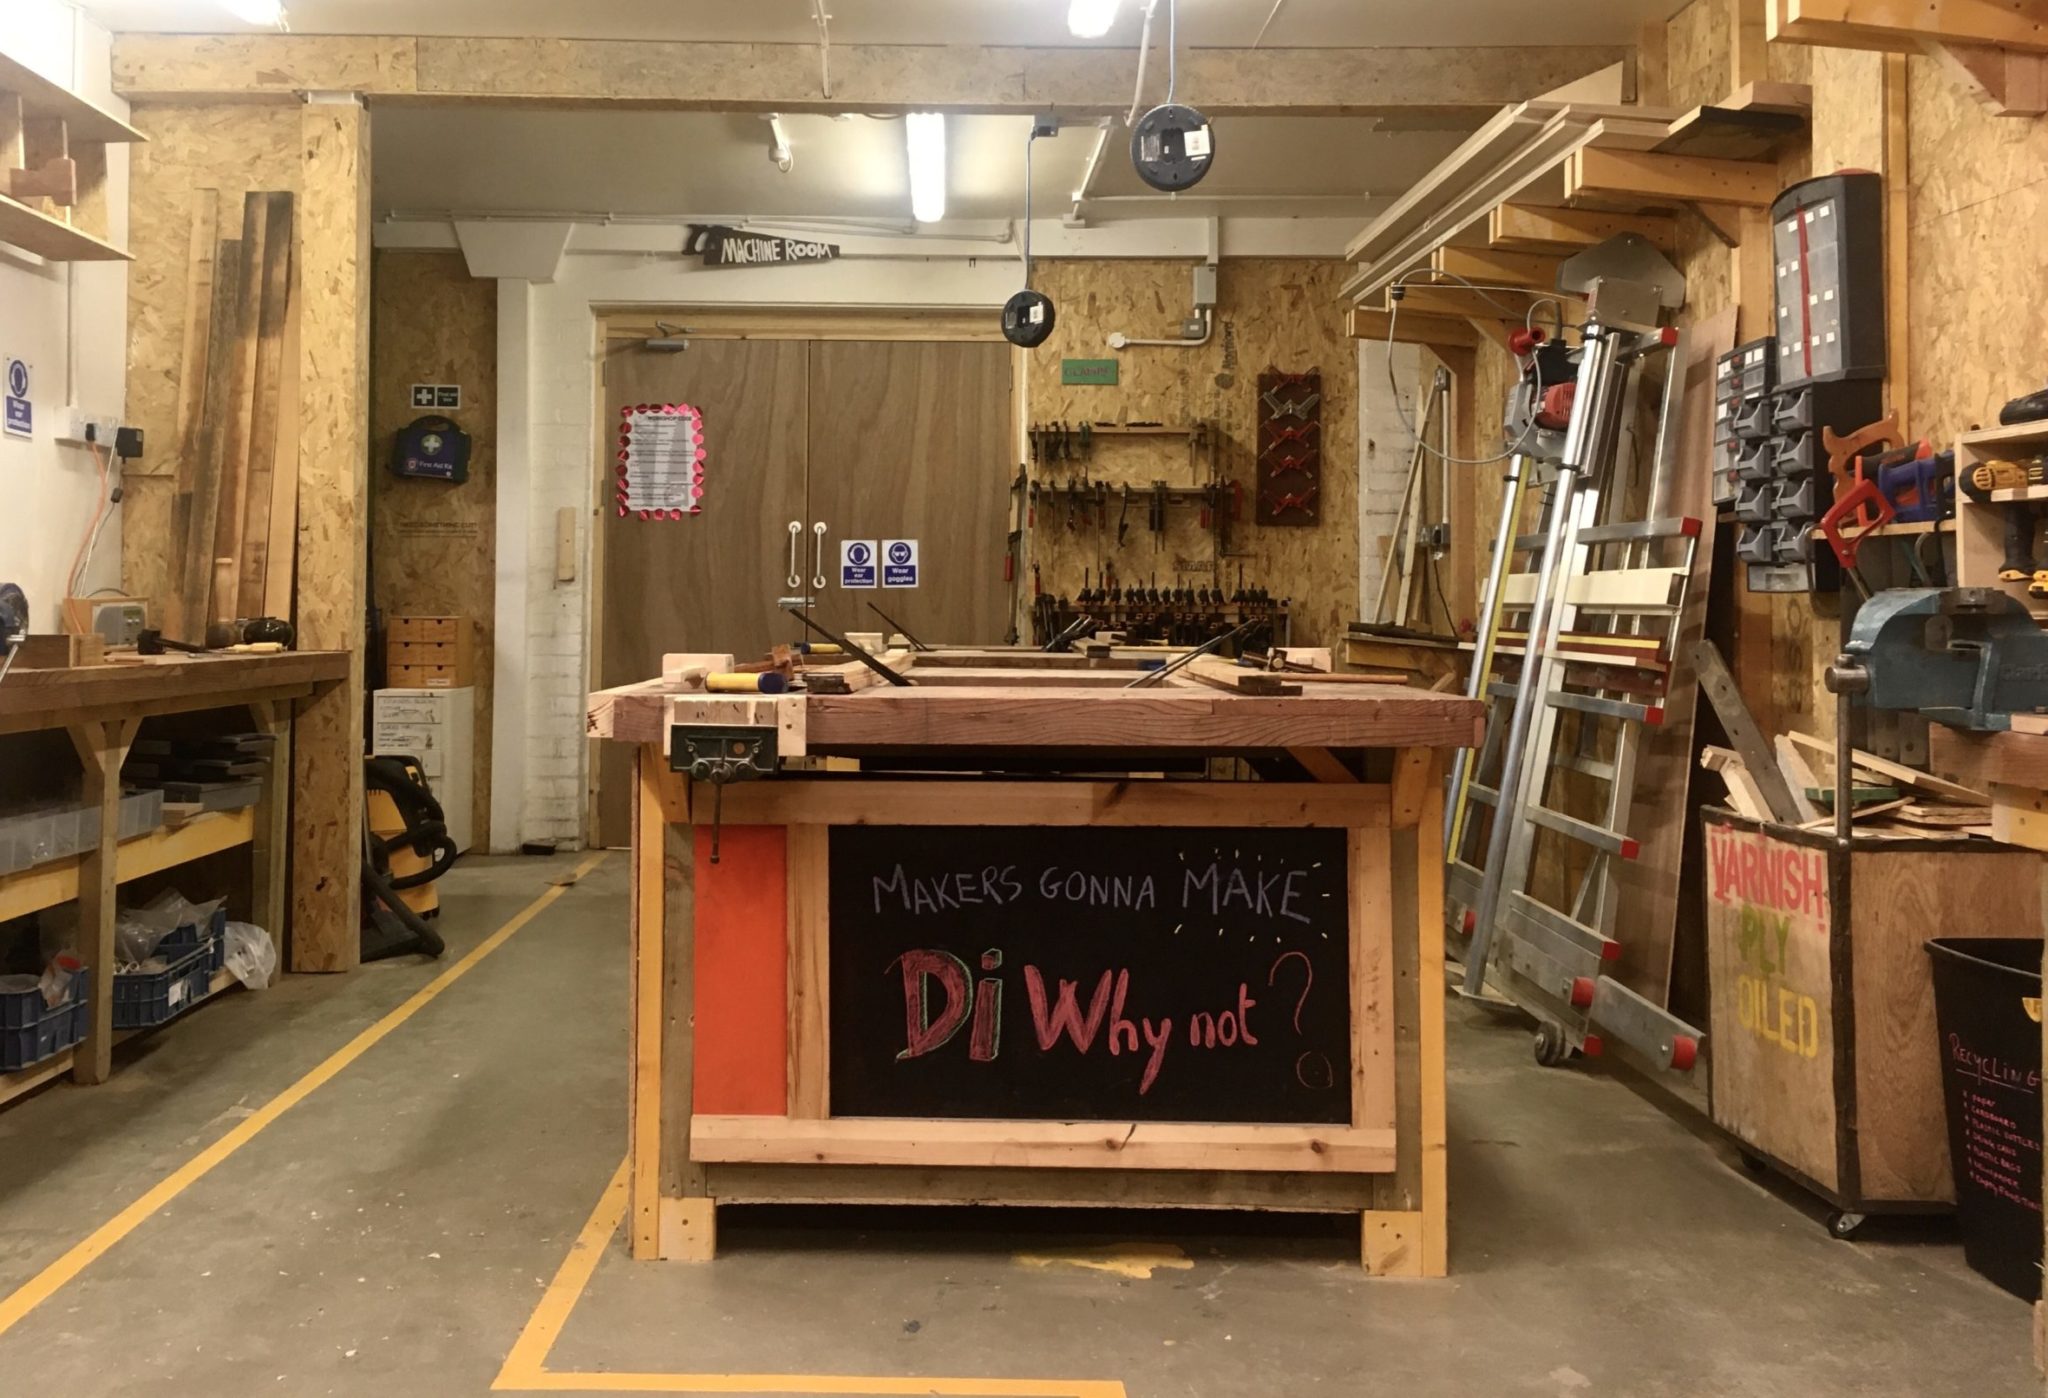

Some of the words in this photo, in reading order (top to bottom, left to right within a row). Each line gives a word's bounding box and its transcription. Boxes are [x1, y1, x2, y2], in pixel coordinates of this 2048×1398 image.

[720, 237, 781, 264] MACHINE
[785, 239, 832, 261] ROOM
[873, 863, 1022, 915] MAKERS
[1039, 866, 1156, 910] GONNA
[1182, 862, 1311, 923] MAKE
[1738, 904, 1791, 975] PLY
[885, 947, 1002, 1063] Di
[1024, 963, 1172, 1096] Why
[1737, 974, 1819, 1060] OILED
